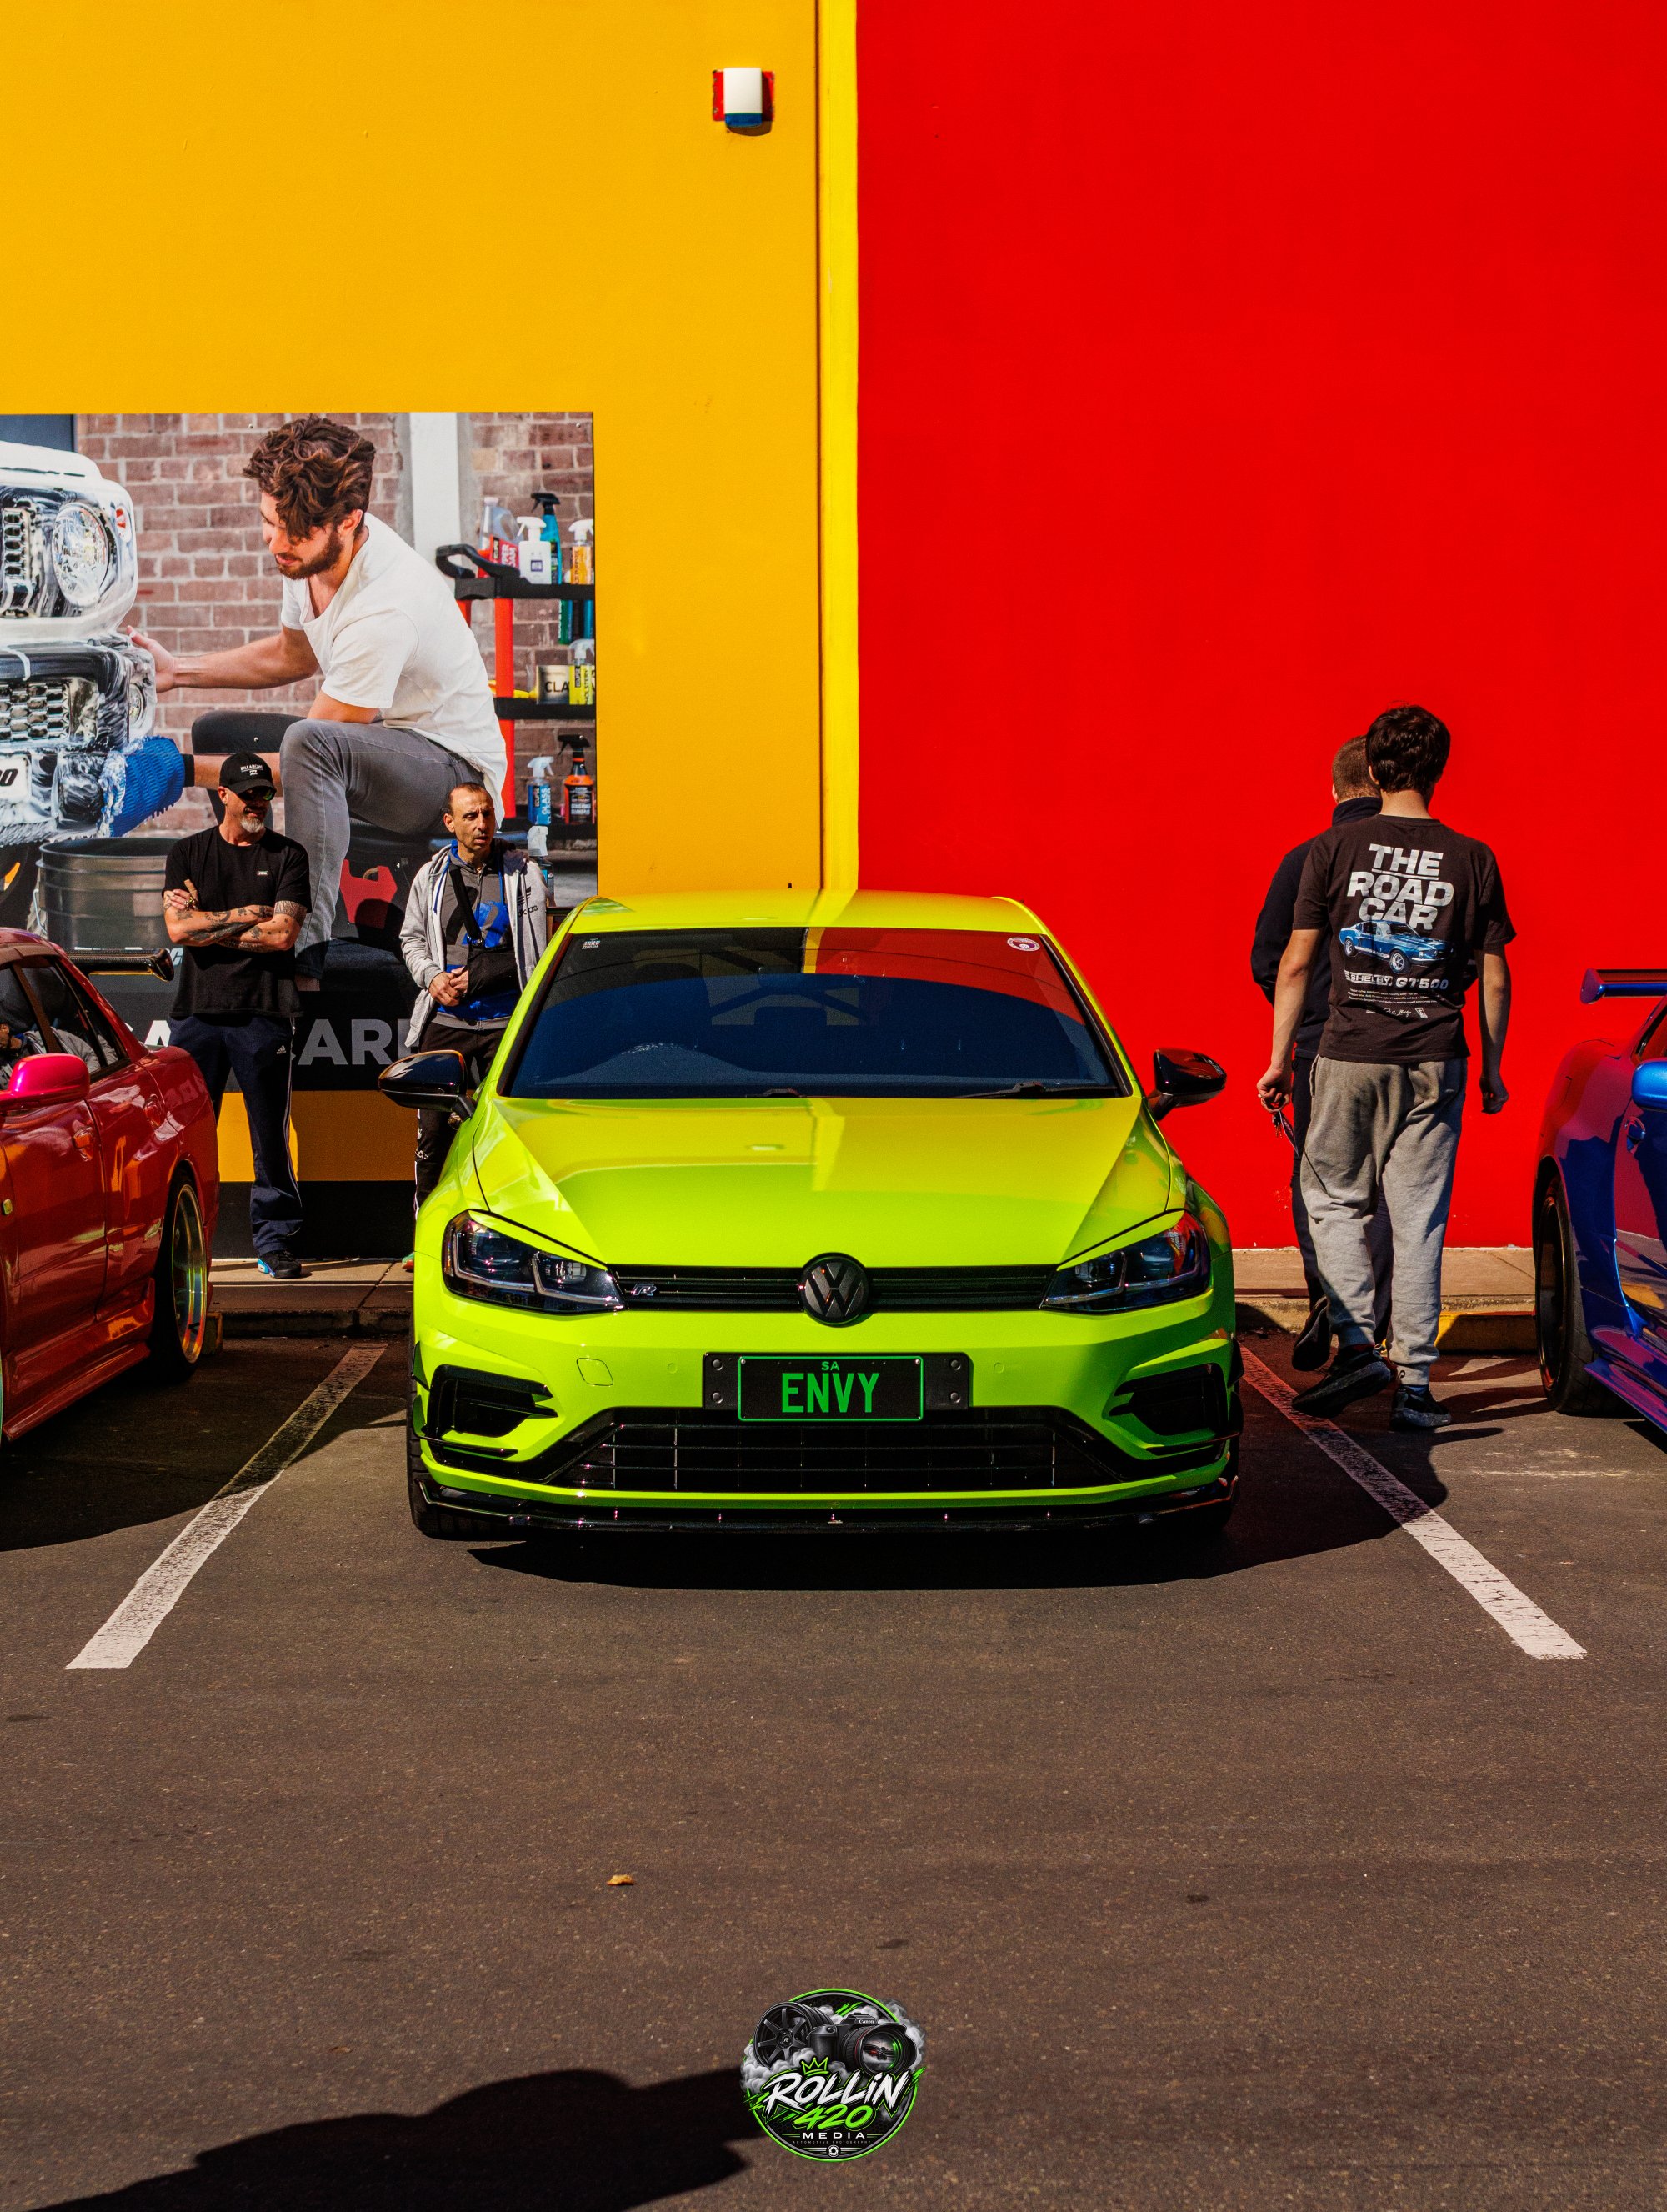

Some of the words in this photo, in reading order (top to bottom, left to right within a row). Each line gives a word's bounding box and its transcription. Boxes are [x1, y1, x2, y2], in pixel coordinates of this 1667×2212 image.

[1369, 843, 1444, 876] THE
[1347, 871, 1454, 907] ROAD
[1359, 897, 1438, 931] CAR
[821, 1361, 840, 1371] SA
[782, 1373, 880, 1413] ENVY
